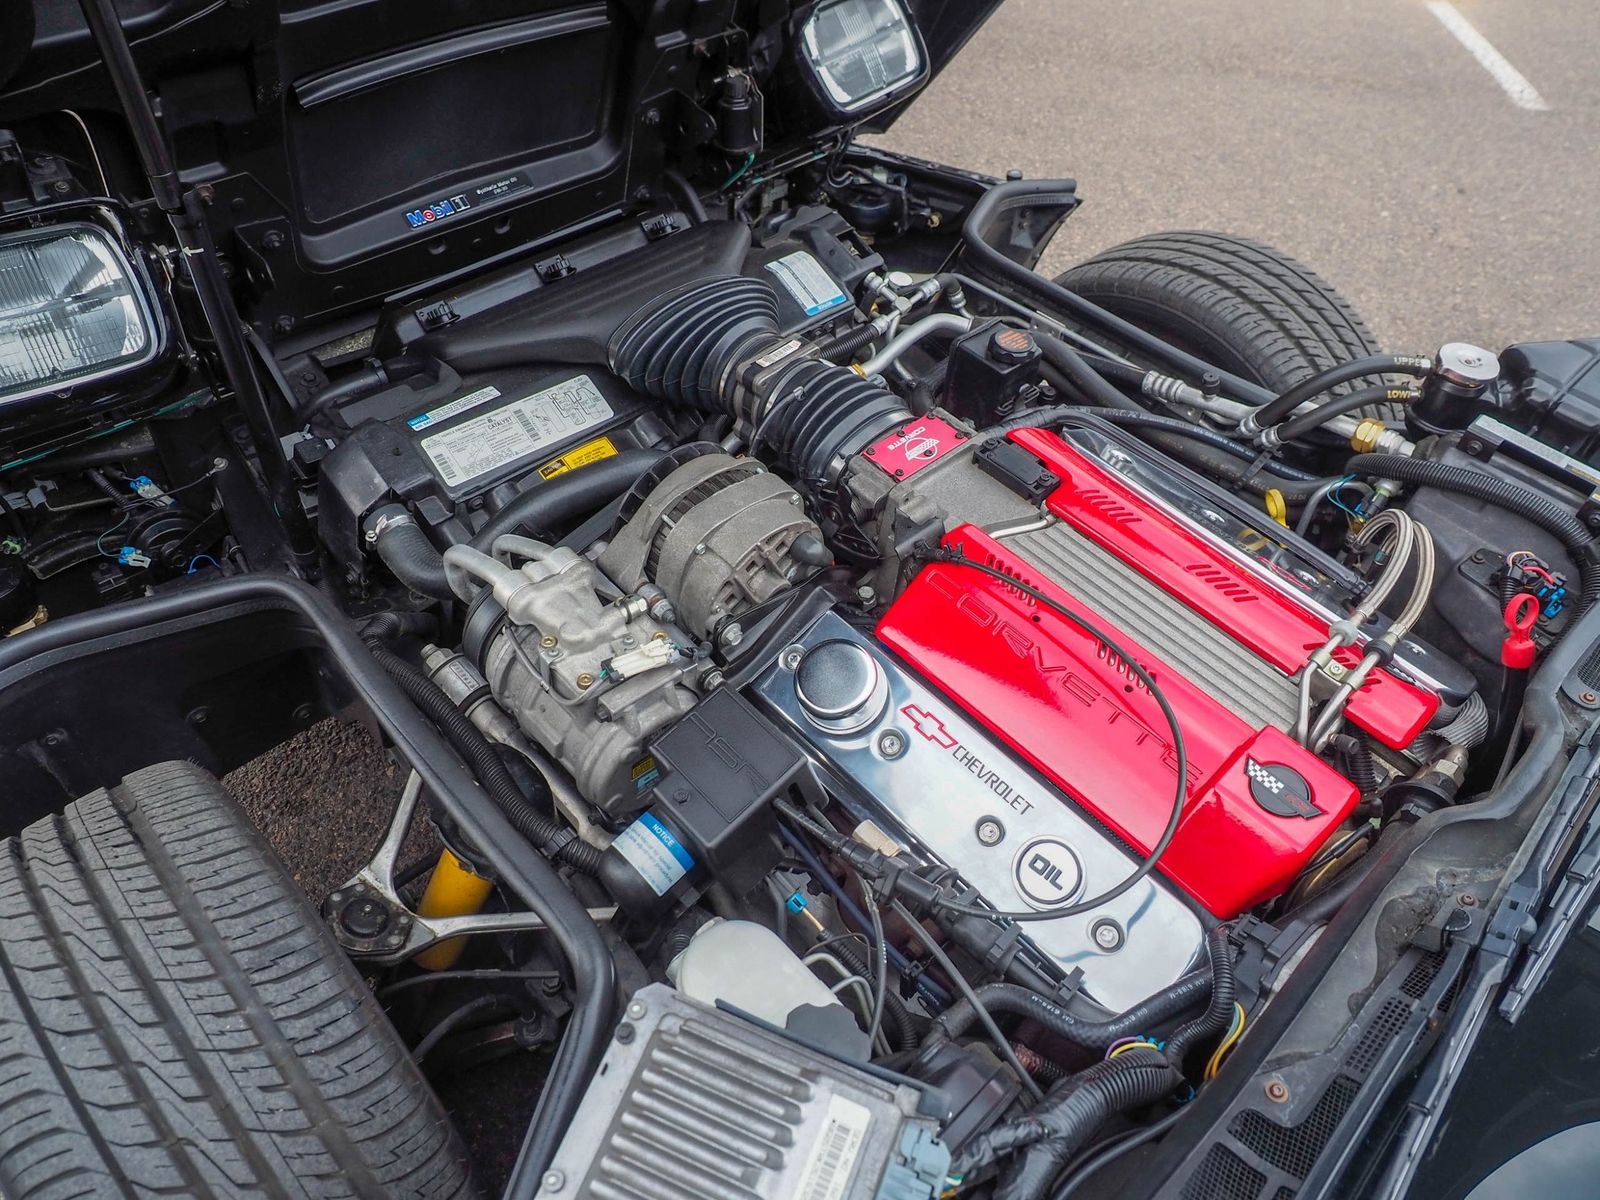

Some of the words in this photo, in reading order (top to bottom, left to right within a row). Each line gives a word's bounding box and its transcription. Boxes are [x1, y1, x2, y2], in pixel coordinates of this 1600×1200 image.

[406, 200, 454, 227] Mobil
[1393, 357, 1422, 367] UPPE
[488, 416, 513, 430] CATALYST
[887, 426, 926, 451] CORVETTE
[924, 568, 1204, 790] CORVETTE
[952, 745, 1034, 815] CHEVROLET
[652, 823, 676, 848] NOTICE
[1028, 853, 1063, 891] OIL
